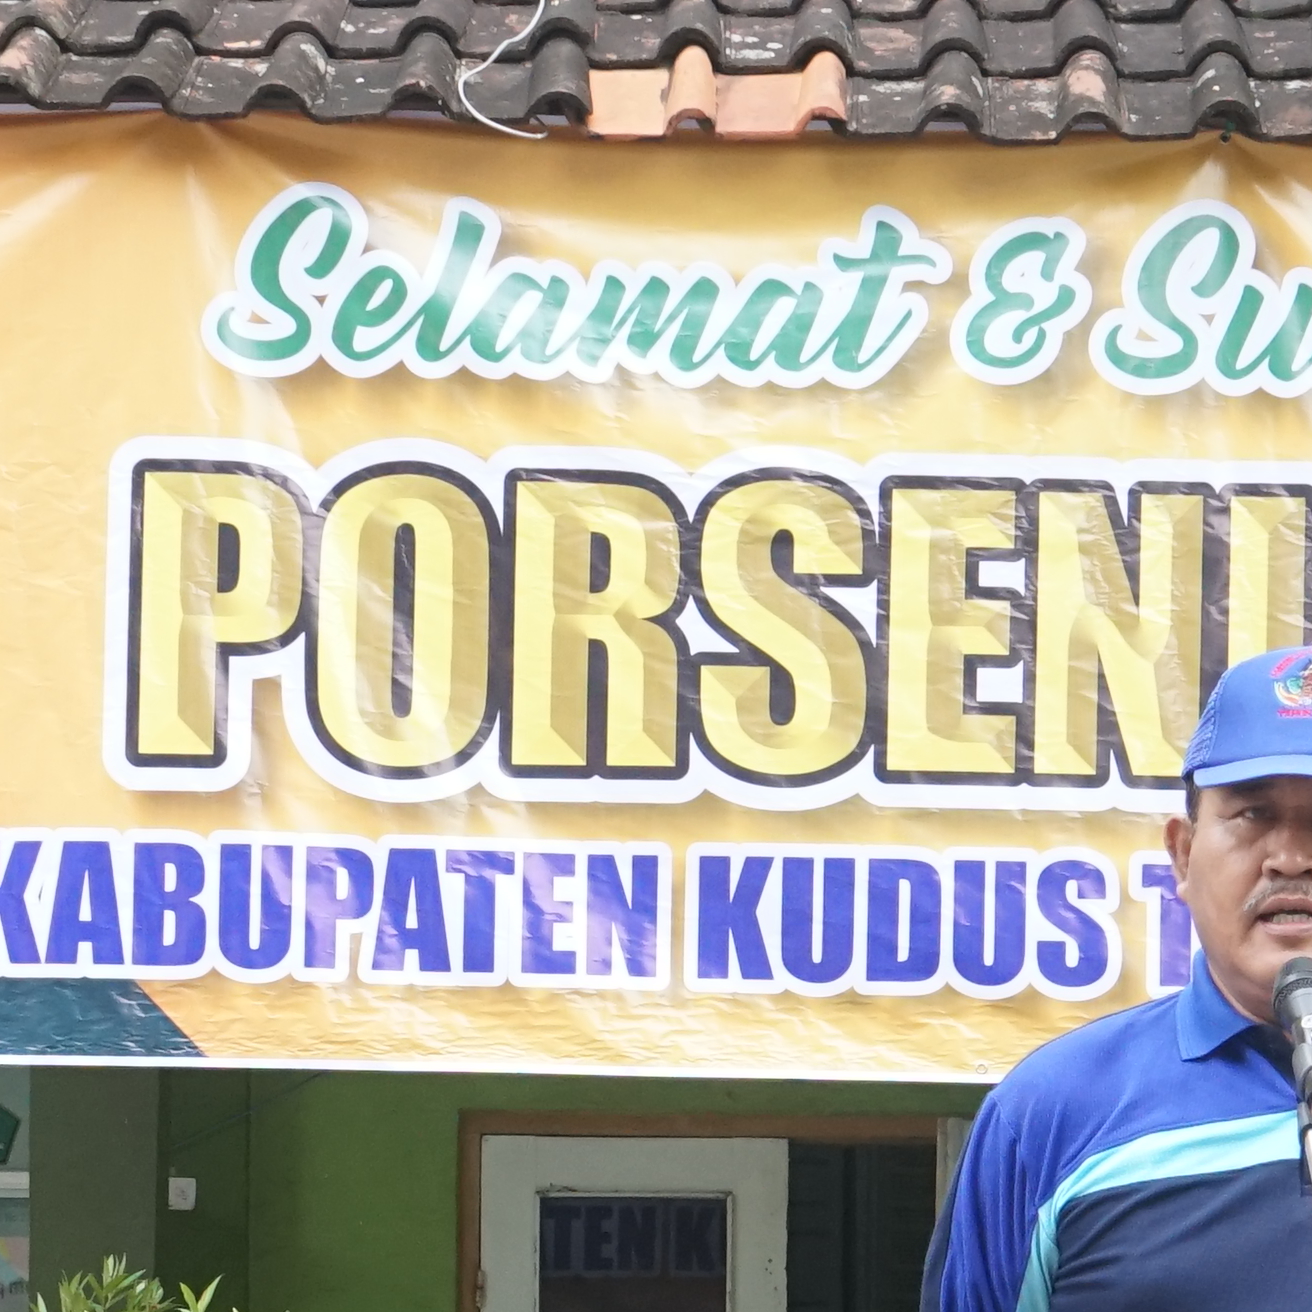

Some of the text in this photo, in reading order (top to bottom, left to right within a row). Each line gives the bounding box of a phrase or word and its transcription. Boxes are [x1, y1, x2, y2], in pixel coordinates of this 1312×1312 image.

[214, 193, 939, 374] Selamat
[964, 230, 1077, 369] &
[695, 854, 1110, 998] KUDUS
